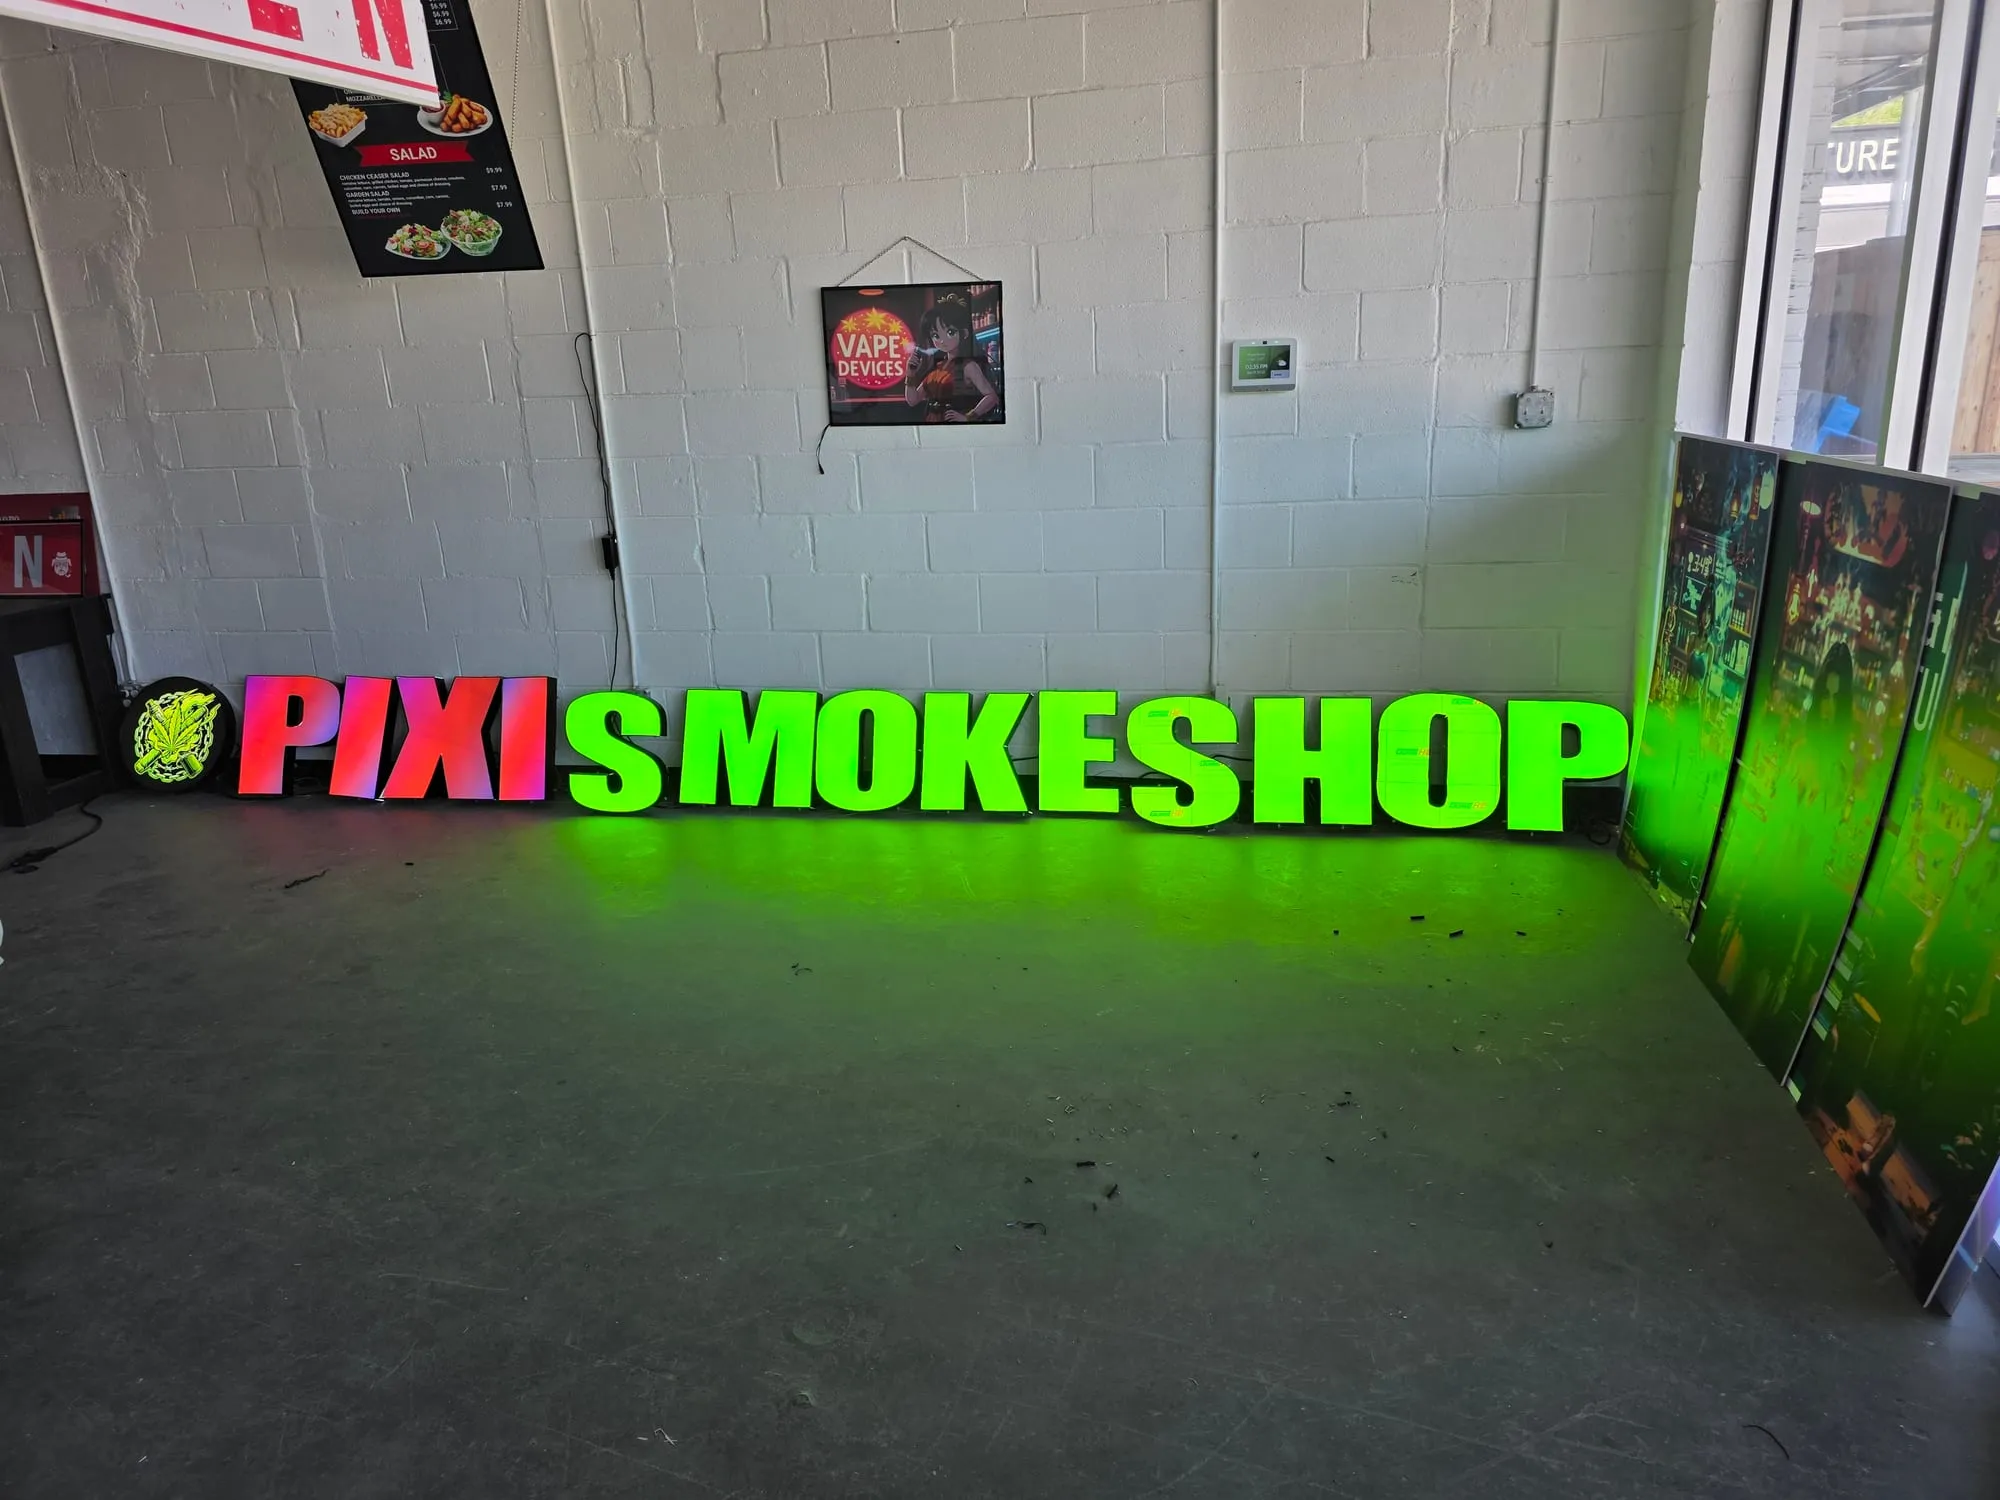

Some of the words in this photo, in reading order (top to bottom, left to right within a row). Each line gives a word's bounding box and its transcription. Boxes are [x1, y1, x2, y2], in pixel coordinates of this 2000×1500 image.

[389, 146, 438, 161] SALAD
[1827, 138, 1899, 174] URE
[836, 333, 901, 358] VAPE
[838, 361, 904, 377] DEVICES
[238, 674, 553, 801] PIXI
